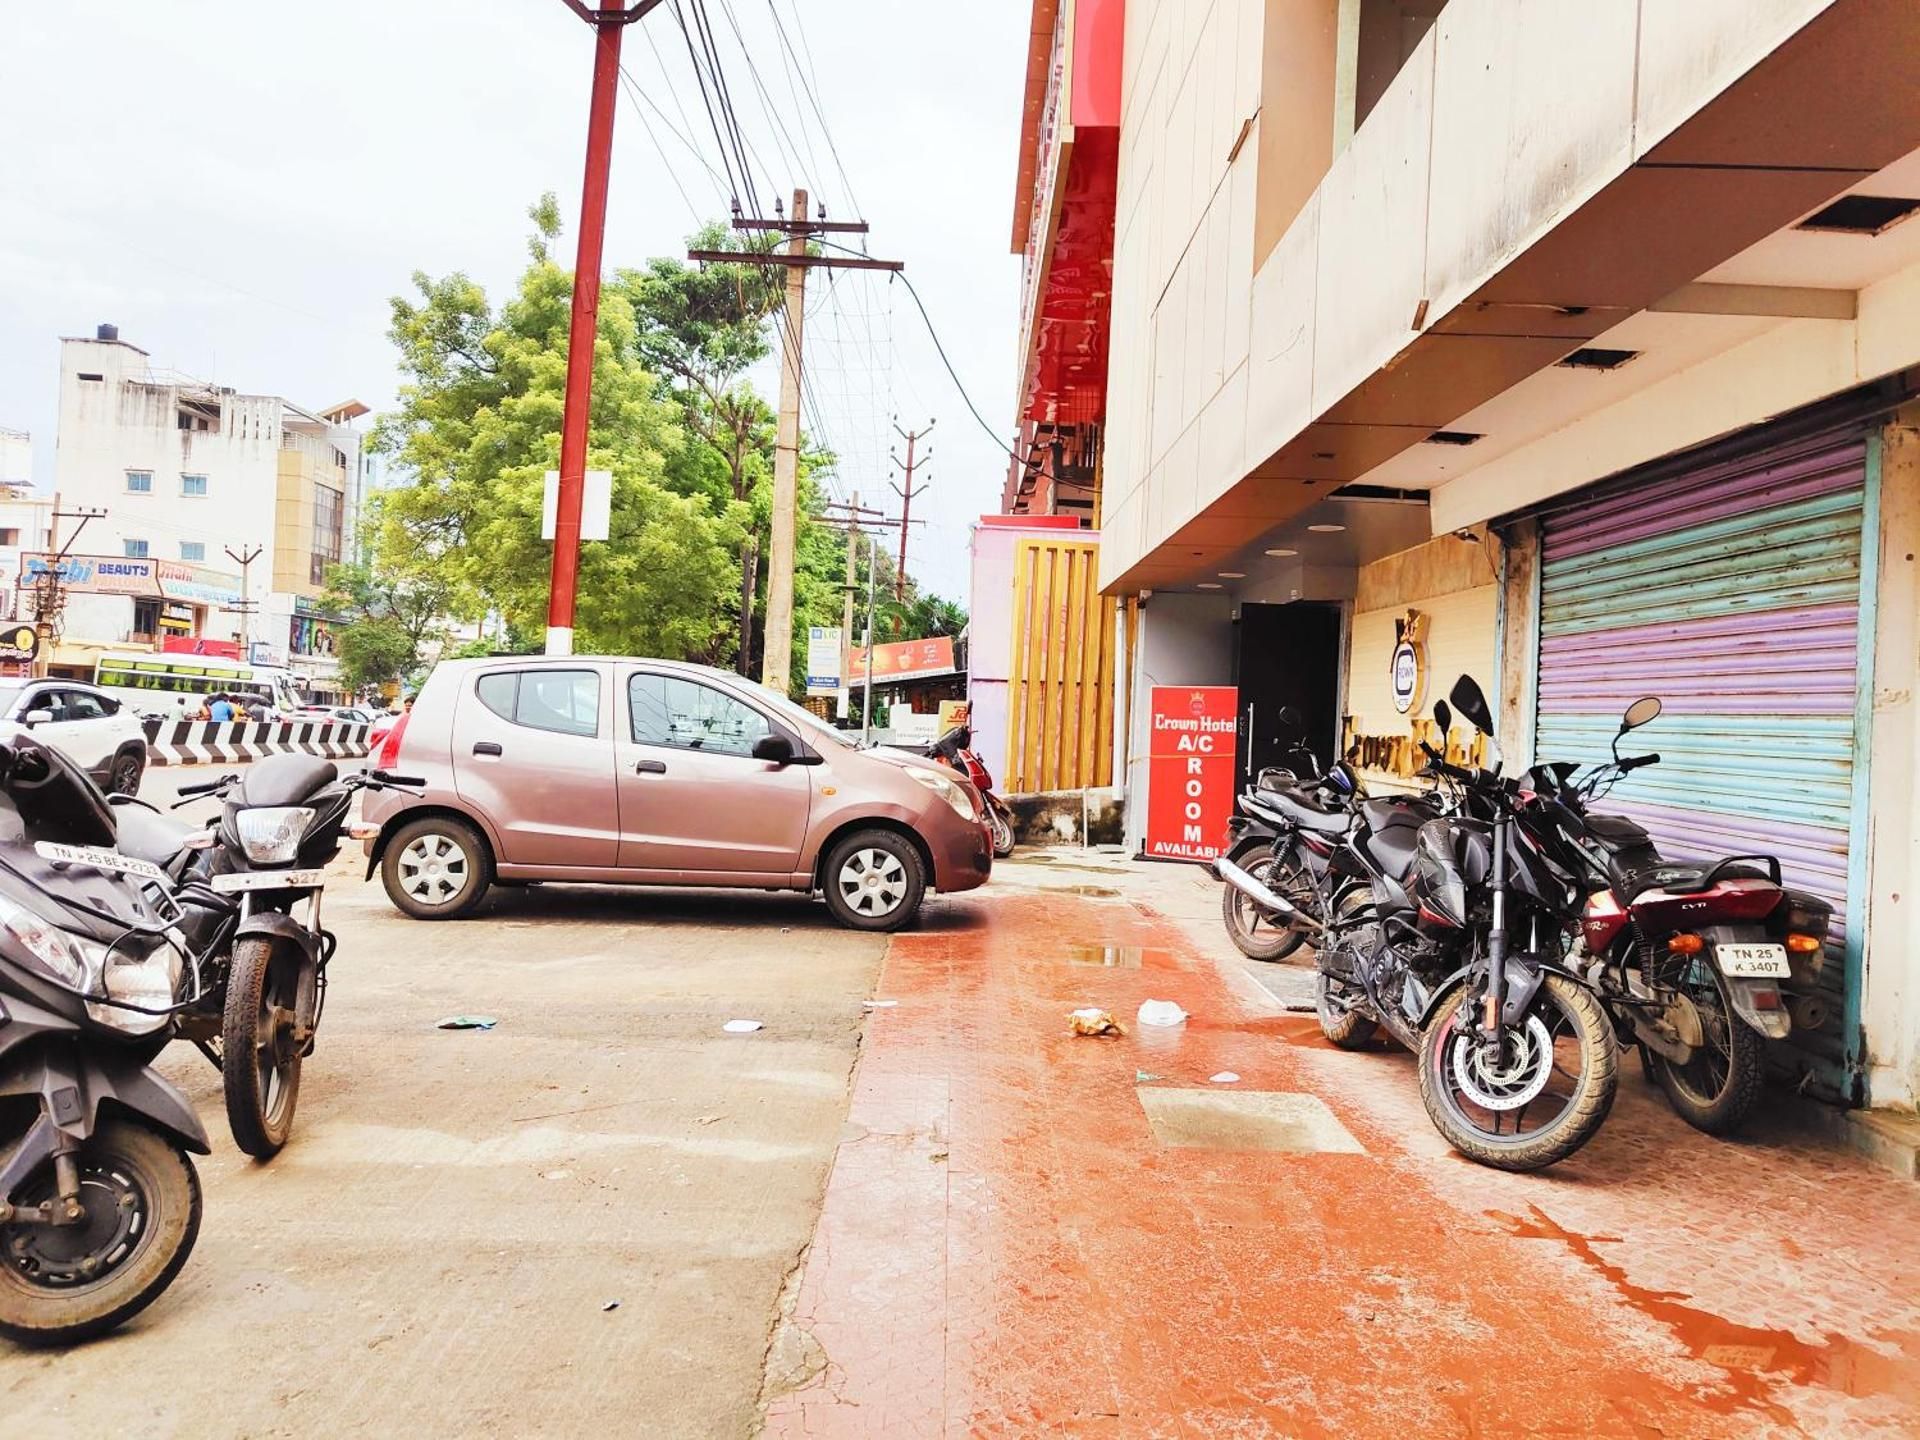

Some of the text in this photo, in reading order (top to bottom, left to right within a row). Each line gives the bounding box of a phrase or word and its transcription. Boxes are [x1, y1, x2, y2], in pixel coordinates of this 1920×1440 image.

[97, 563, 149, 577] BEAUTY
[1155, 713, 1237, 732] Crown Hotel
[1177, 734, 1214, 753] A/C
[1183, 757, 1203, 842] ROOM
[53, 847, 72, 858] TN
[1154, 841, 1227, 859] AVAILABL
[1733, 948, 1773, 959] TN 25
[1735, 962, 1779, 972] K 3407
